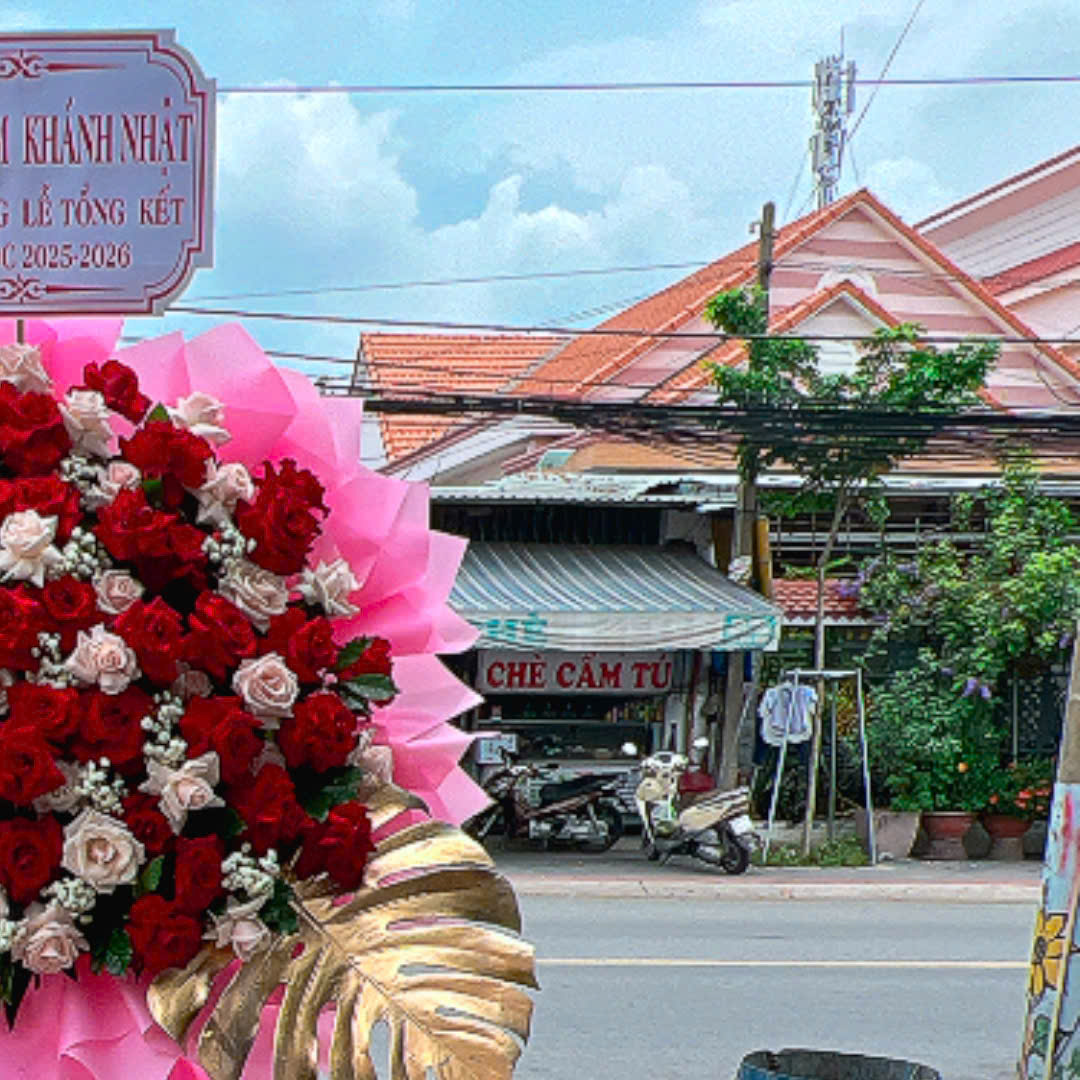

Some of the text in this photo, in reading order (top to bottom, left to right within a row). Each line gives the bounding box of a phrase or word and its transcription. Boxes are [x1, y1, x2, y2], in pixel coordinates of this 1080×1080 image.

[23, 96, 114, 165] KHÁNH
[120, 96, 194, 176] NHẬT
[22, 182, 53, 227] LỄ
[59, 182, 127, 227] TỔNG
[139, 181, 186, 226] KẾT
[22, 241, 133, 270] 2025-2026
[486, 652, 547, 689] CHÈ
[631, 652, 672, 689] TÚ
